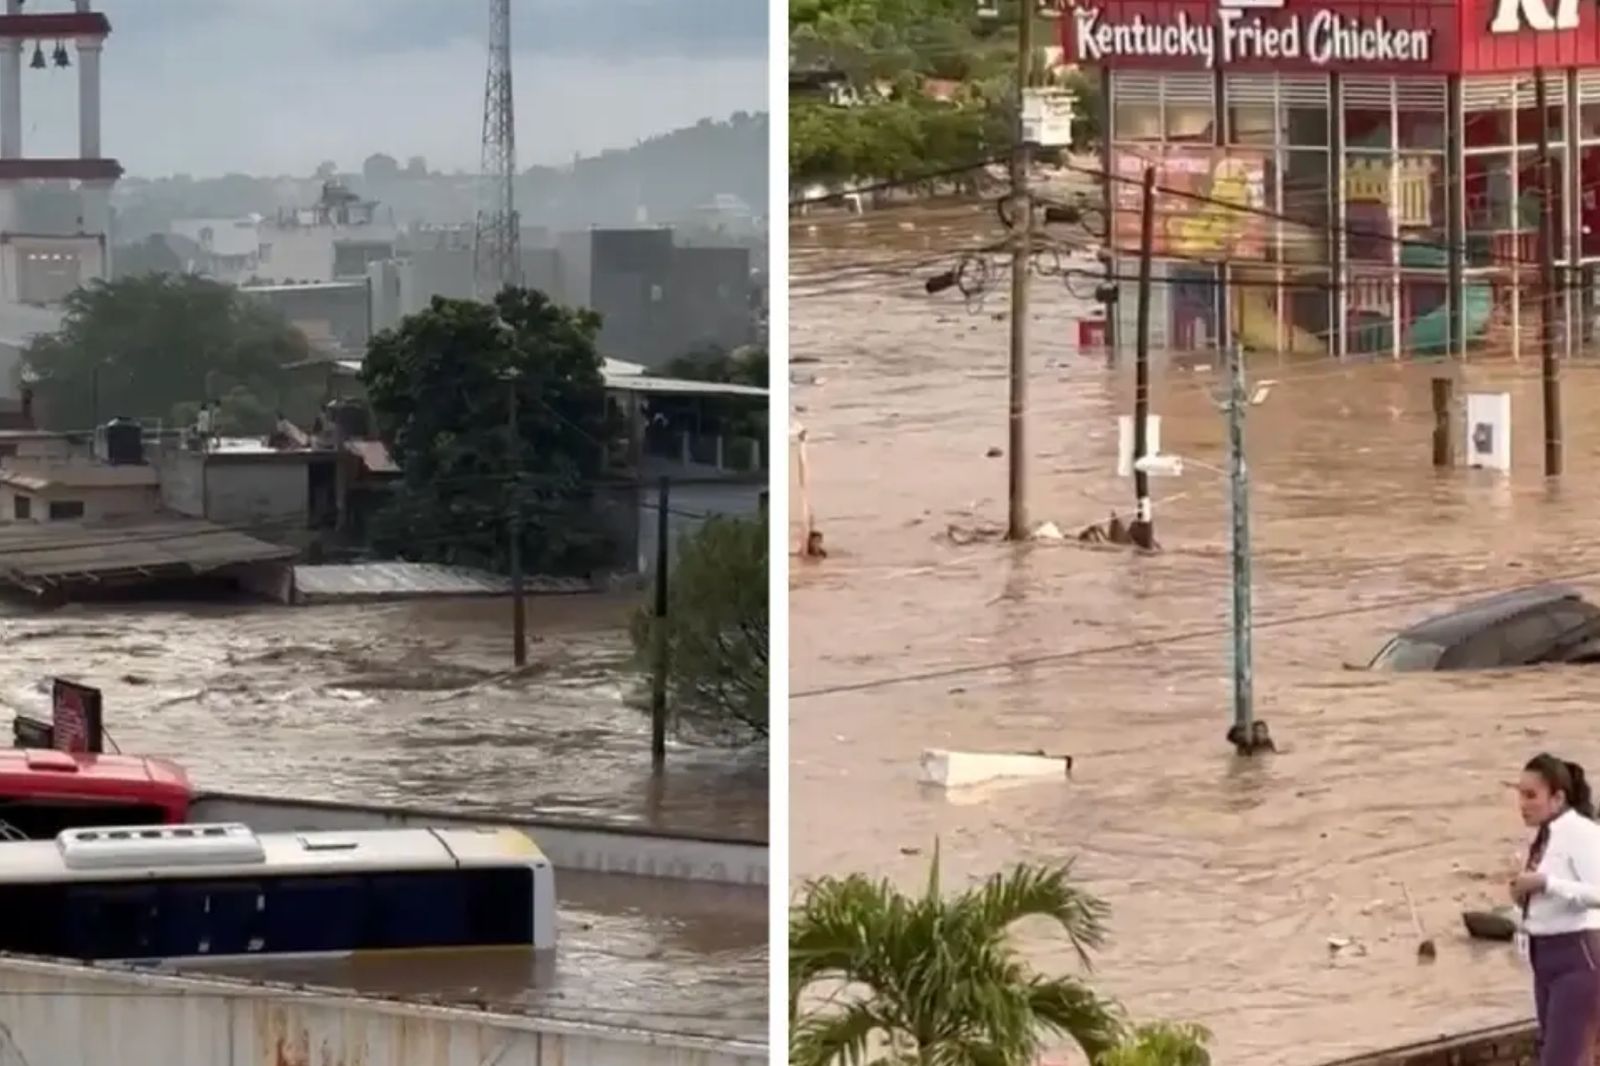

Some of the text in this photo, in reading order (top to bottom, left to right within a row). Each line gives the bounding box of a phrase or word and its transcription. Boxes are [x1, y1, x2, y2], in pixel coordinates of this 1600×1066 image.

[1073, 6, 1213, 68] Kentucky
[1218, 9, 1299, 62] Fried
[1307, 9, 1429, 64] Chicken
